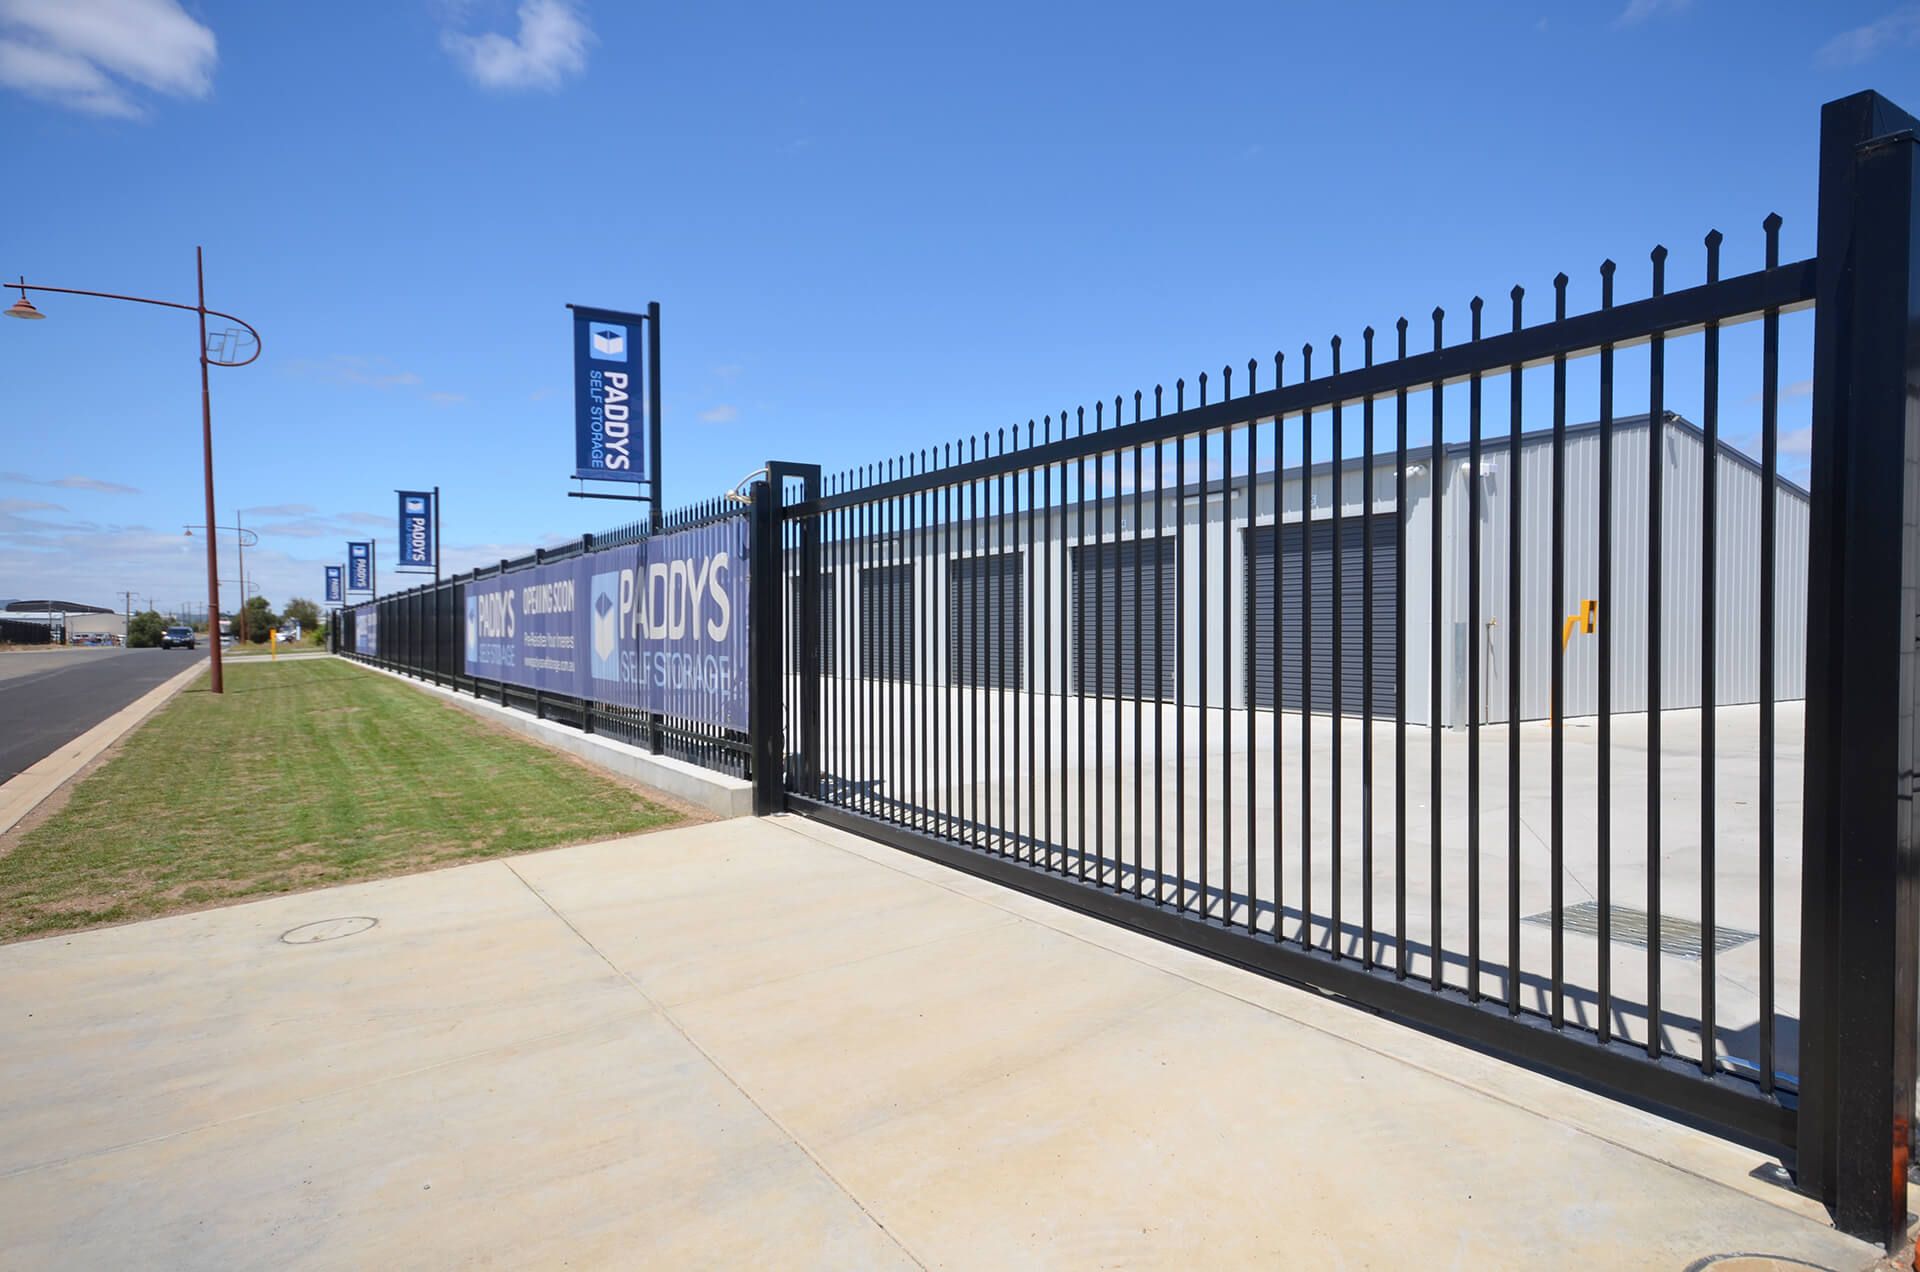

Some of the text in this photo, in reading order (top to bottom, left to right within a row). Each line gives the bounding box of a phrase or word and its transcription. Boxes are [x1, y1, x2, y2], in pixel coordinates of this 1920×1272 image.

[590, 370, 603, 468] SELF STORAGE
[603, 371, 630, 470] PADDYS
[412, 517, 426, 561] PADDYS
[478, 588, 516, 638] PADDYS
[523, 578, 575, 615] OPENING SOON
[620, 552, 730, 643] PADDYS
[620, 650, 731, 697] SELF STORAGE
